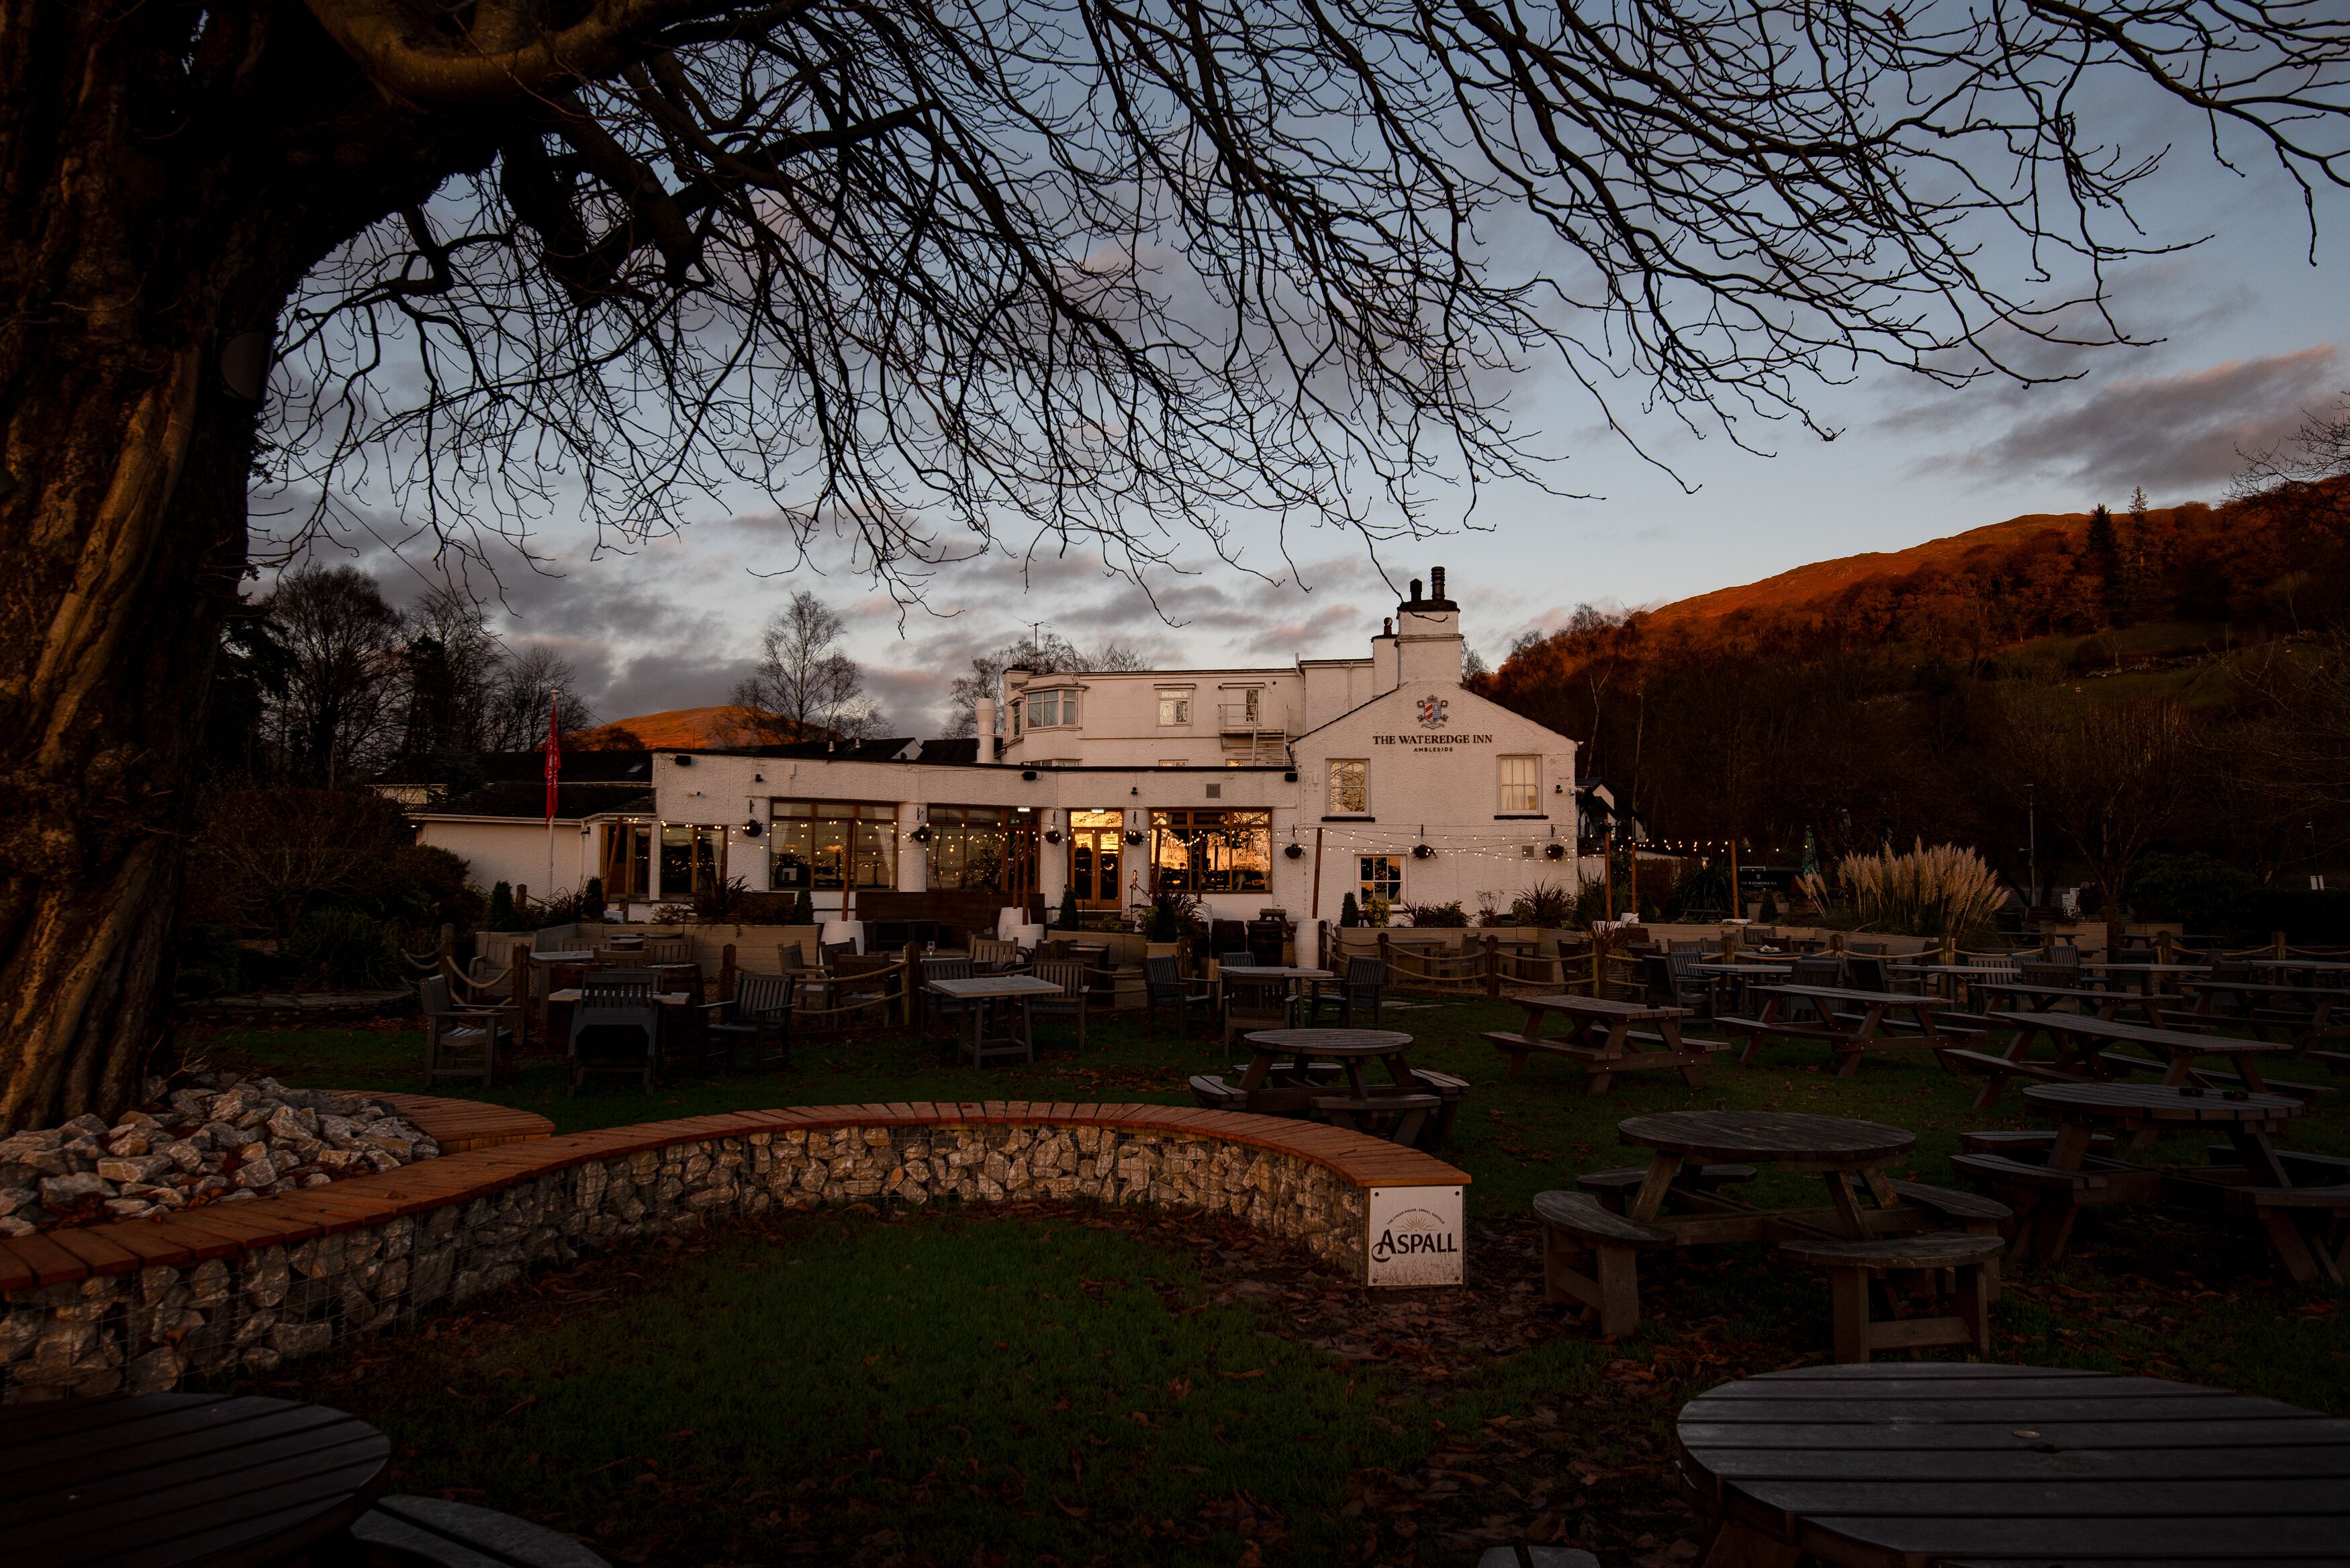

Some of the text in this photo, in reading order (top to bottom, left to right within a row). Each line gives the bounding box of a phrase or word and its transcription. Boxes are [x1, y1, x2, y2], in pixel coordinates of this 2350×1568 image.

[1373, 734, 1493, 744] THE WATEREDGE INN
[1393, 1211, 1405, 1220] CYDER
[1431, 1212, 1445, 1225] SUFFOLK
[1371, 1228, 1458, 1263] ASPALL
